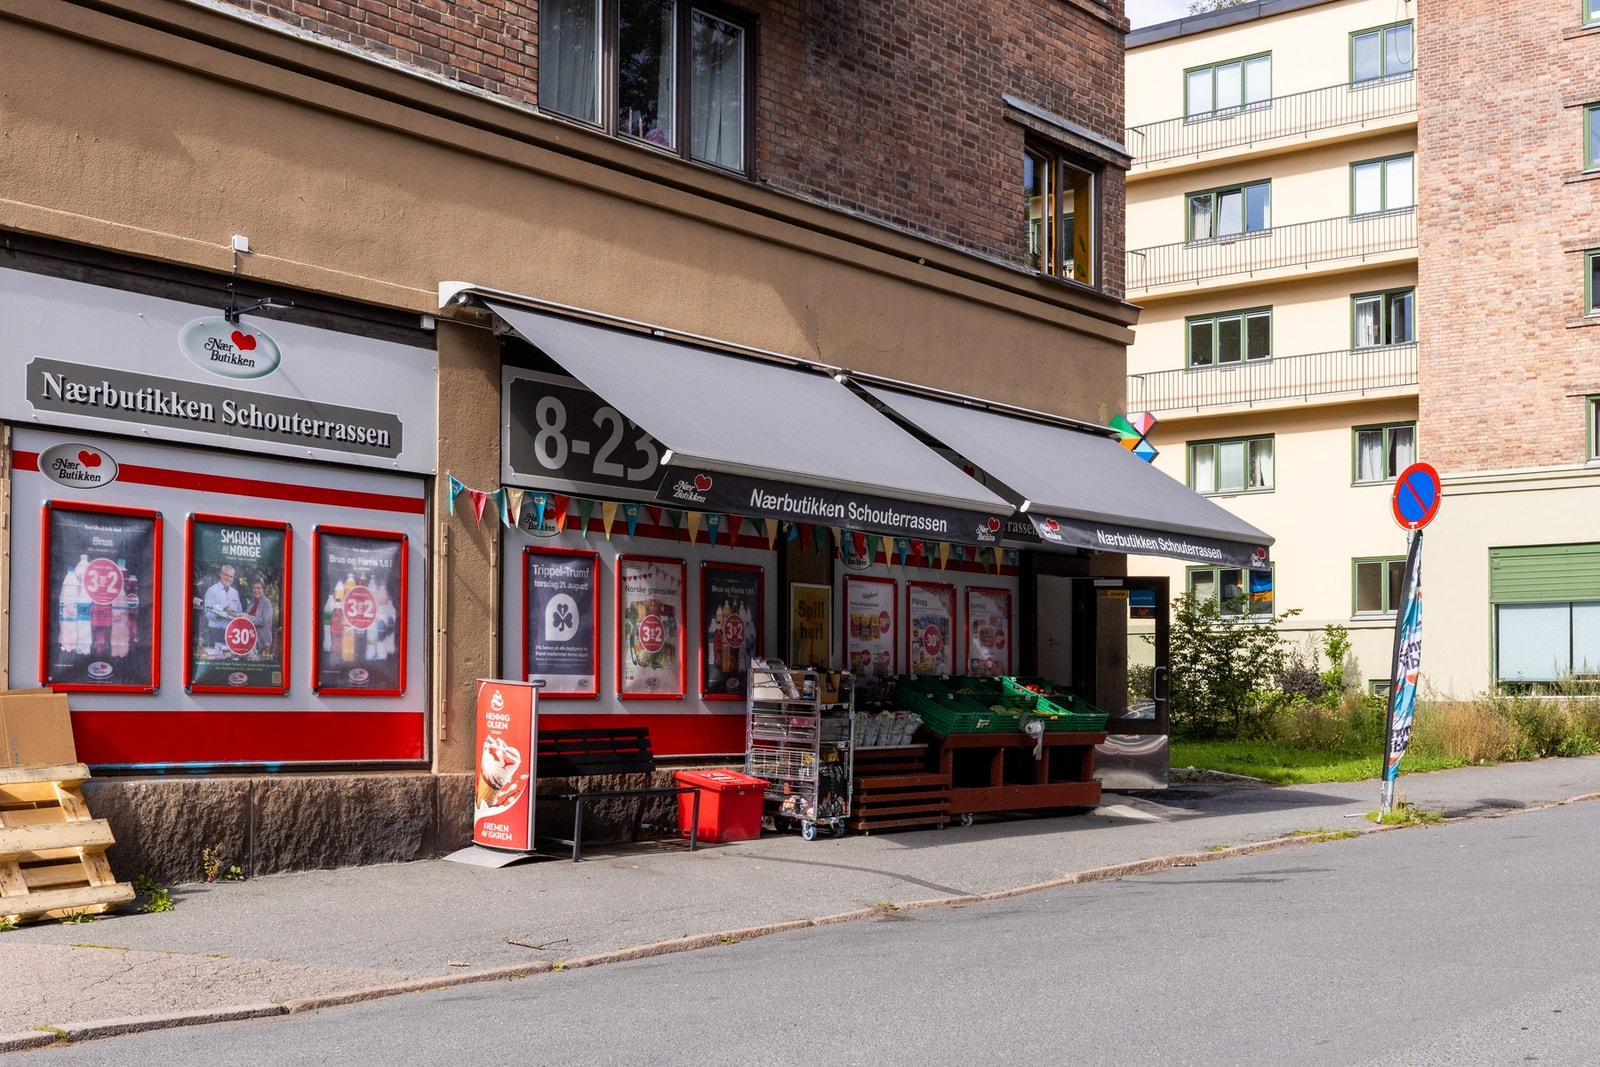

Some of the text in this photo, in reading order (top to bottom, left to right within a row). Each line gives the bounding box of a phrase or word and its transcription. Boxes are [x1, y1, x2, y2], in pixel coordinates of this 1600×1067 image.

[204, 336, 234, 352] Nær
[210, 349, 255, 368] Butikken
[41, 370, 391, 448] Nærbutikken Schouterrassen
[52, 457, 80, 472] Nær
[58, 467, 102, 483] Butikken
[673, 480, 694, 491] Nær
[674, 490, 706, 503] Butikken
[750, 488, 948, 533] Nærbutikken Schouterrassen
[92, 536, 114, 547] Brus
[221, 529, 261, 546] SMAKEN
[1097, 529, 1223, 560] Nærbutikken Schouterrassen
[230, 545, 261, 558] NORGE
[329, 554, 346, 564] Brus
[347, 557, 357, 567] og
[357, 557, 379, 568] Farris
[532, 564, 590, 579] Trippel-Trumf
[88, 569, 99, 593] 3
[107, 570, 119, 594] 2
[534, 579, 558, 590] torsdag
[625, 585, 647, 594] Norske
[347, 598, 357, 618] 3
[363, 599, 374, 618] 2
[798, 600, 825, 619] Spill
[643, 626, 650, 642] 3
[655, 626, 662, 642] 2
[727, 622, 744, 640] 3 2
[800, 622, 823, 640] her!
[485, 711, 511, 723] HENNIG
[486, 721, 508, 730] OLSEN
[483, 821, 510, 833] KREMEN
